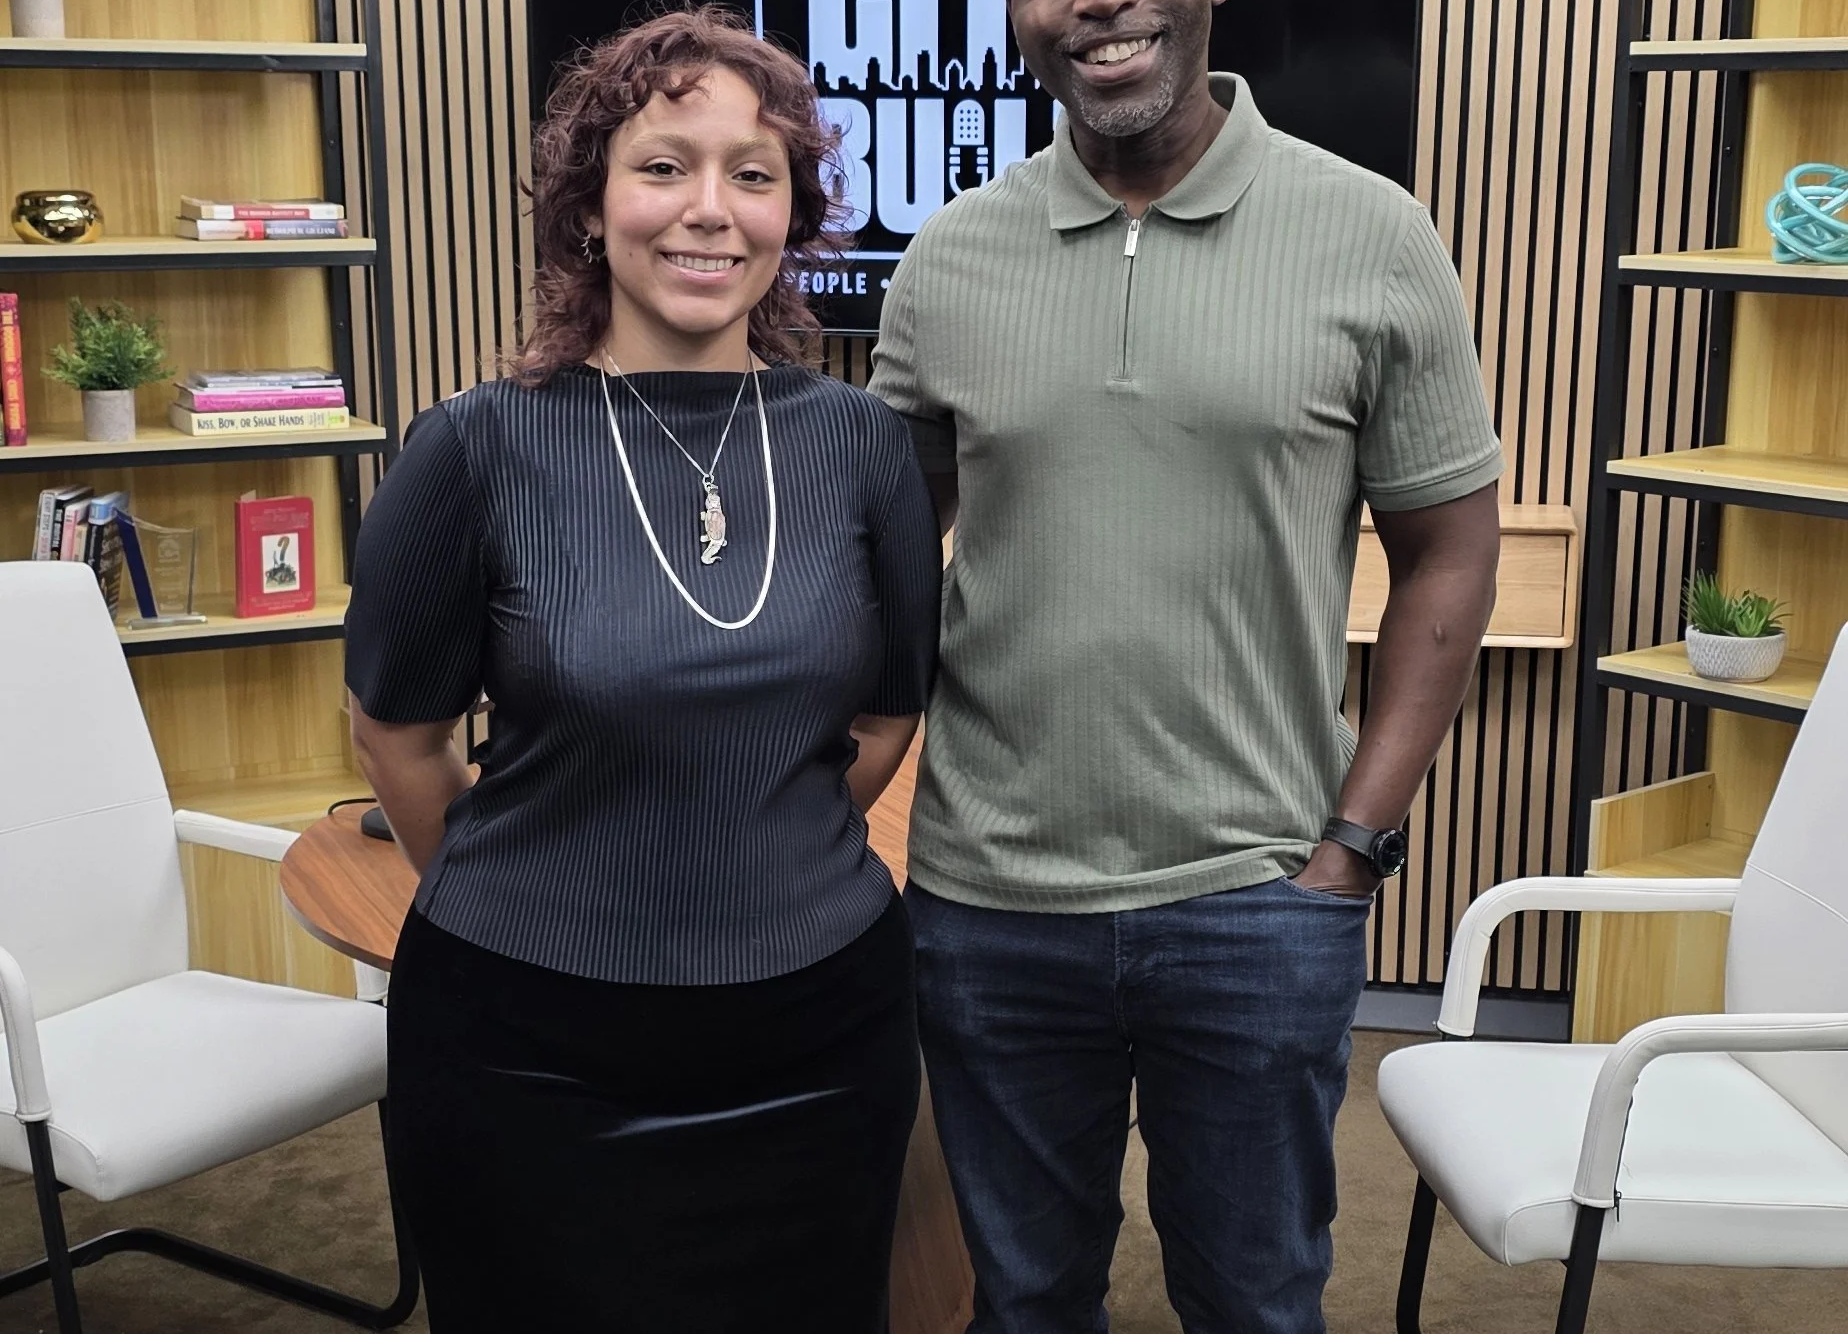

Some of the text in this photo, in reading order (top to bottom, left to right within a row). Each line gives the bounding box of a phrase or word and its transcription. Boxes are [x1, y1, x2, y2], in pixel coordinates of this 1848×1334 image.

[240, 417, 251, 428] OR
[253, 415, 277, 428] SHAKE
[278, 414, 304, 427] HANDS
